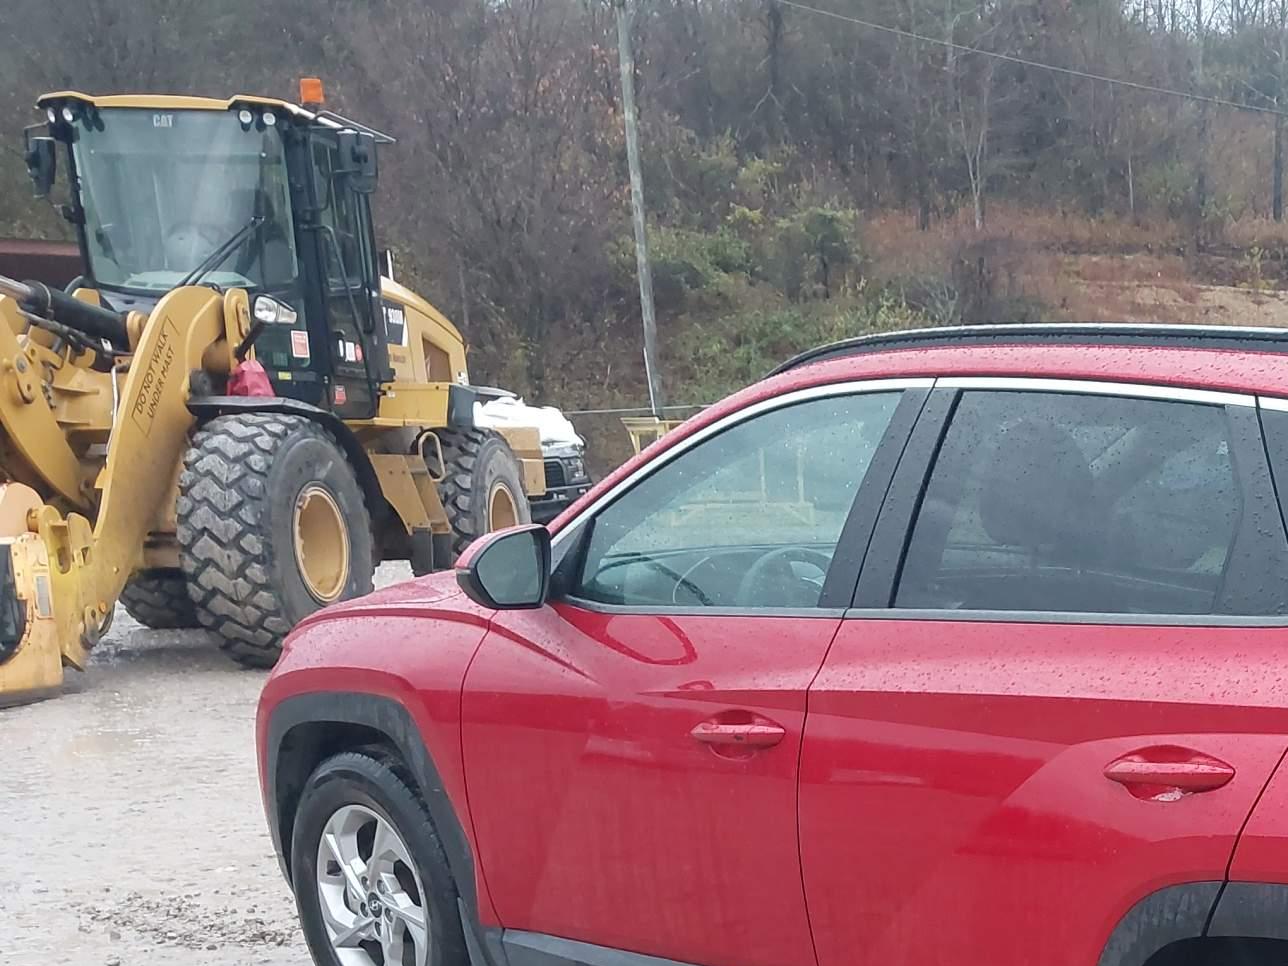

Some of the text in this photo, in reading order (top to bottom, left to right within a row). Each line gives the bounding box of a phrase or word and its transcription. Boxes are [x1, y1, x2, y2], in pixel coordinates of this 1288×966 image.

[153, 114, 173, 128] CAT
[137, 332, 169, 414] DO NOT WALK
[147, 345, 175, 418] UNDER MAST
